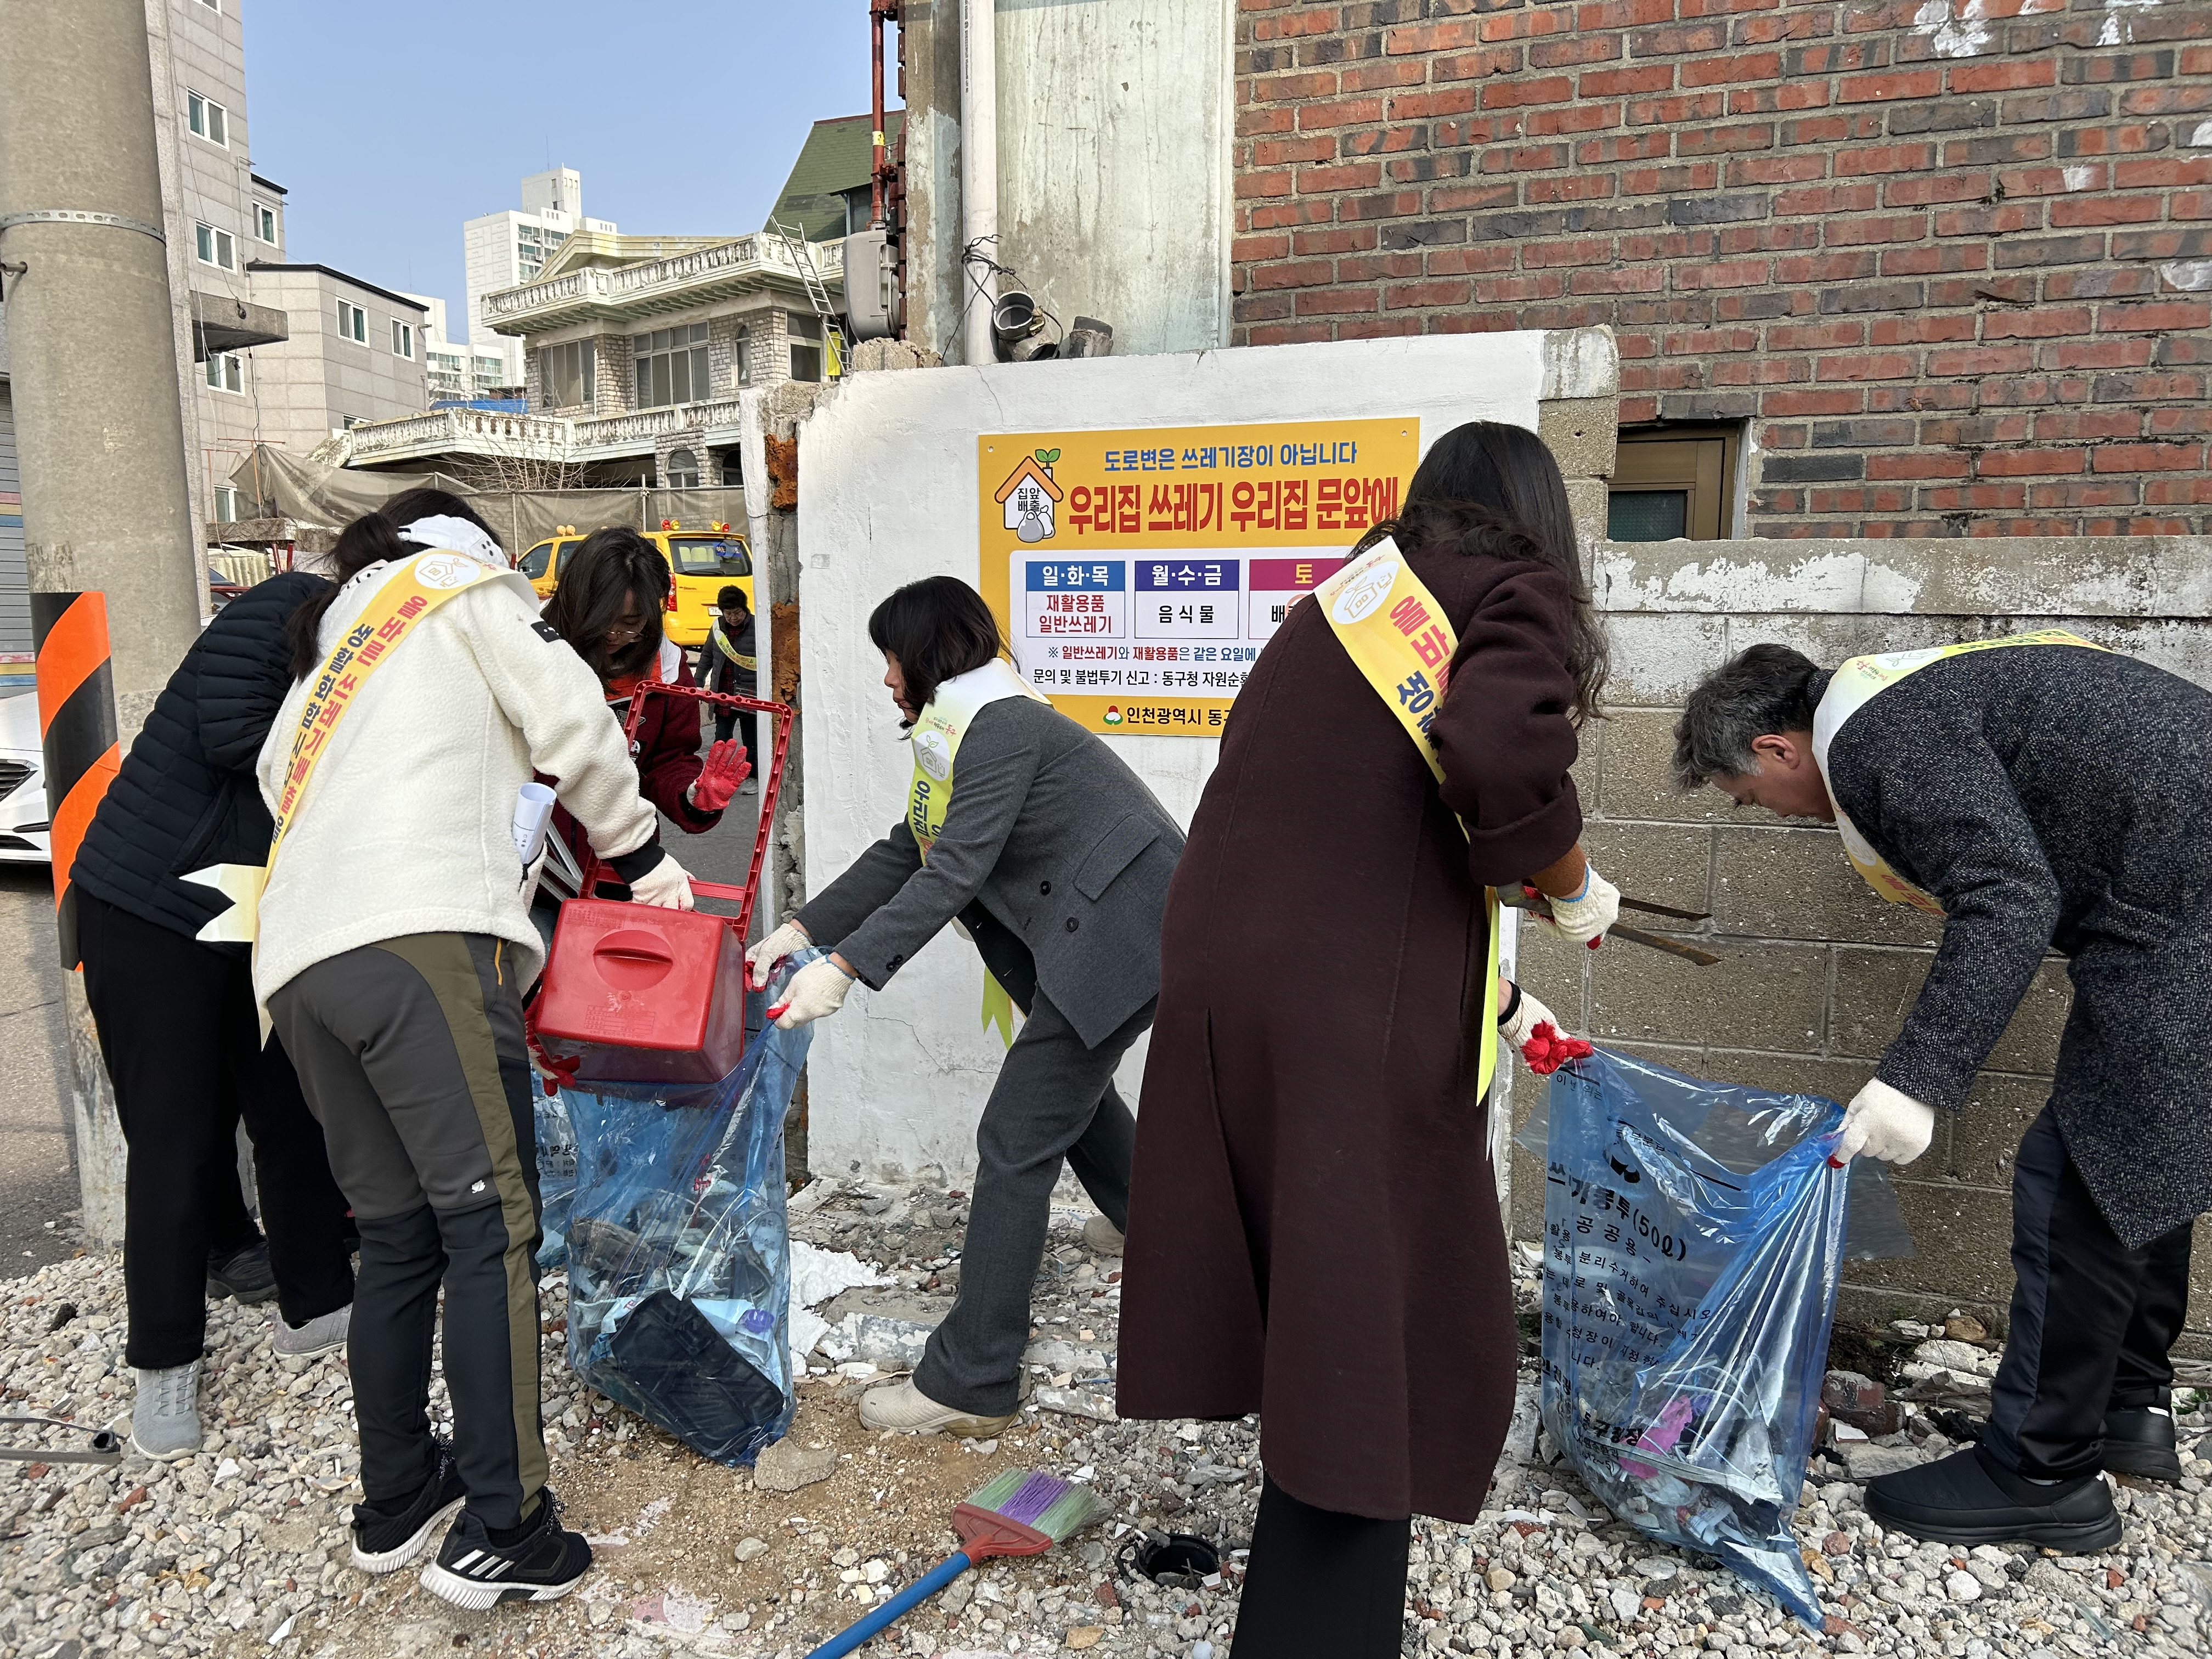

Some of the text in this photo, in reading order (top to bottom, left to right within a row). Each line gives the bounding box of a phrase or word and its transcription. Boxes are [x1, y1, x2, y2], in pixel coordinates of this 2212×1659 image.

[1105, 441, 1357, 471] 도로변은 쓰레기장이 아닙니다
[1018, 487, 1041, 500] 집앞
[1069, 476, 1398, 535] 우리집 쓰레기 우리집 문앞에
[1042, 565, 1109, 586] 일·화·목
[1152, 565, 1222, 586] 월·수·금
[1295, 563, 1313, 584] 토
[1046, 594, 1105, 613] 재활용품
[357, 595, 428, 667] 올바른
[1039, 615, 1111, 634] 일반쓰레기
[1062, 646, 1130, 660] 일반쓰레기와
[1133, 646, 1190, 661] 재활용품은
[1193, 647, 1217, 661] 같은
[1221, 647, 1256, 662] 요일에
[1033, 669, 1056, 684] 문의
[1060, 669, 1071, 685] 및
[1075, 669, 1122, 685] 불법투기
[1126, 670, 1150, 686] 신고
[1162, 671, 1198, 687] 동구청
[303, 672, 357, 756] 쓰레기
[1127, 707, 1201, 725] 인천광역시
